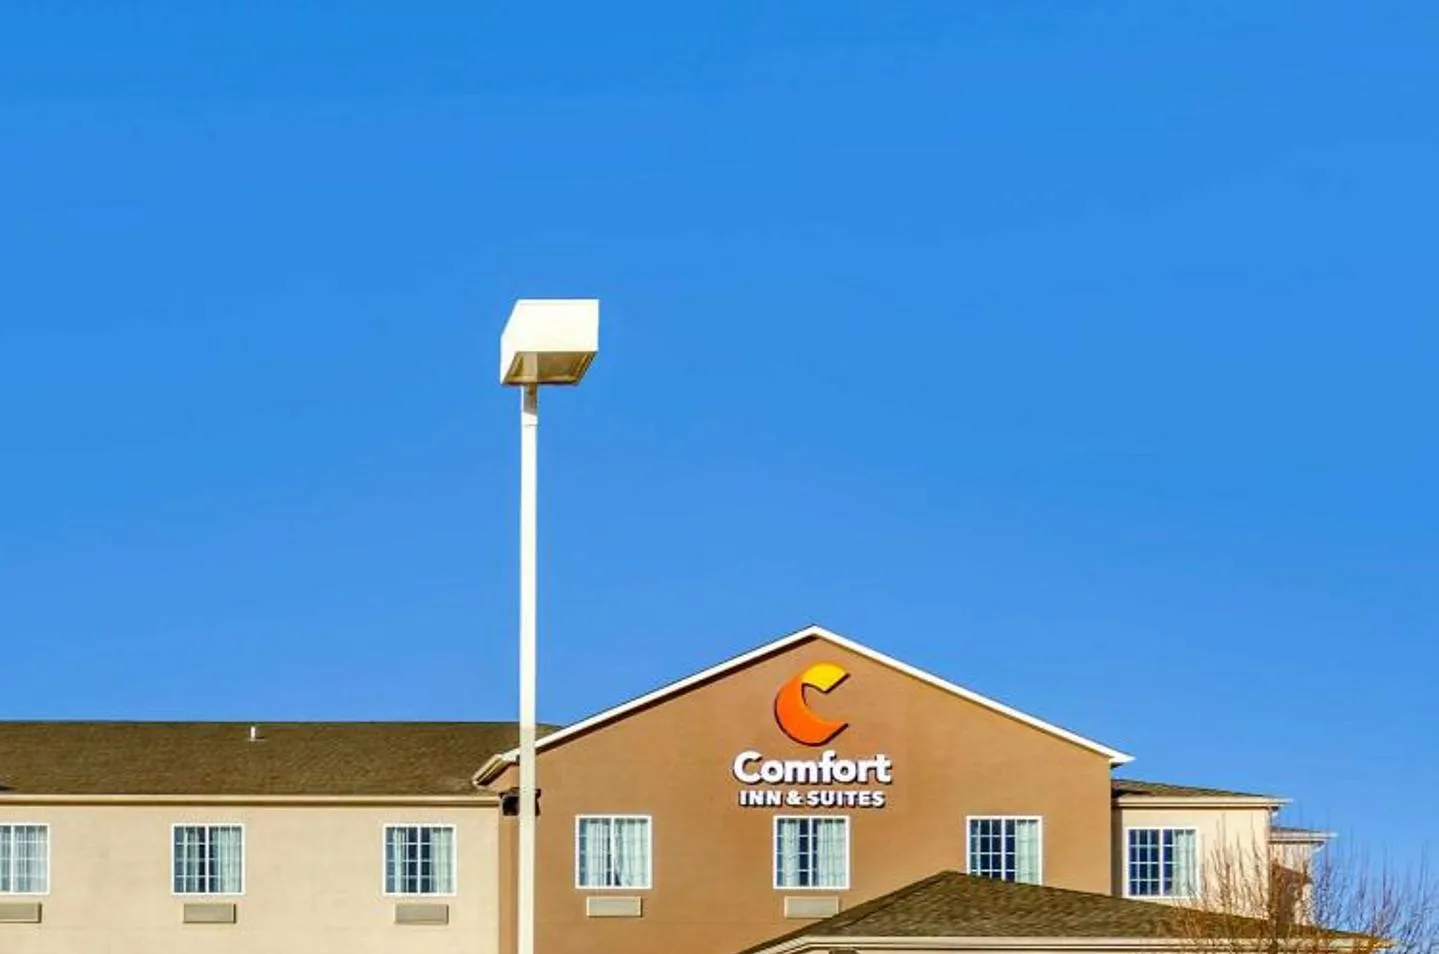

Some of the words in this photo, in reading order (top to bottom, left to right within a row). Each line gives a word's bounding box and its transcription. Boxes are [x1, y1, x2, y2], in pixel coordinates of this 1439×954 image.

[733, 750, 892, 783] Comfort
[740, 790, 782, 806] INN
[785, 790, 804, 806] &
[807, 790, 885, 807] SUITES
